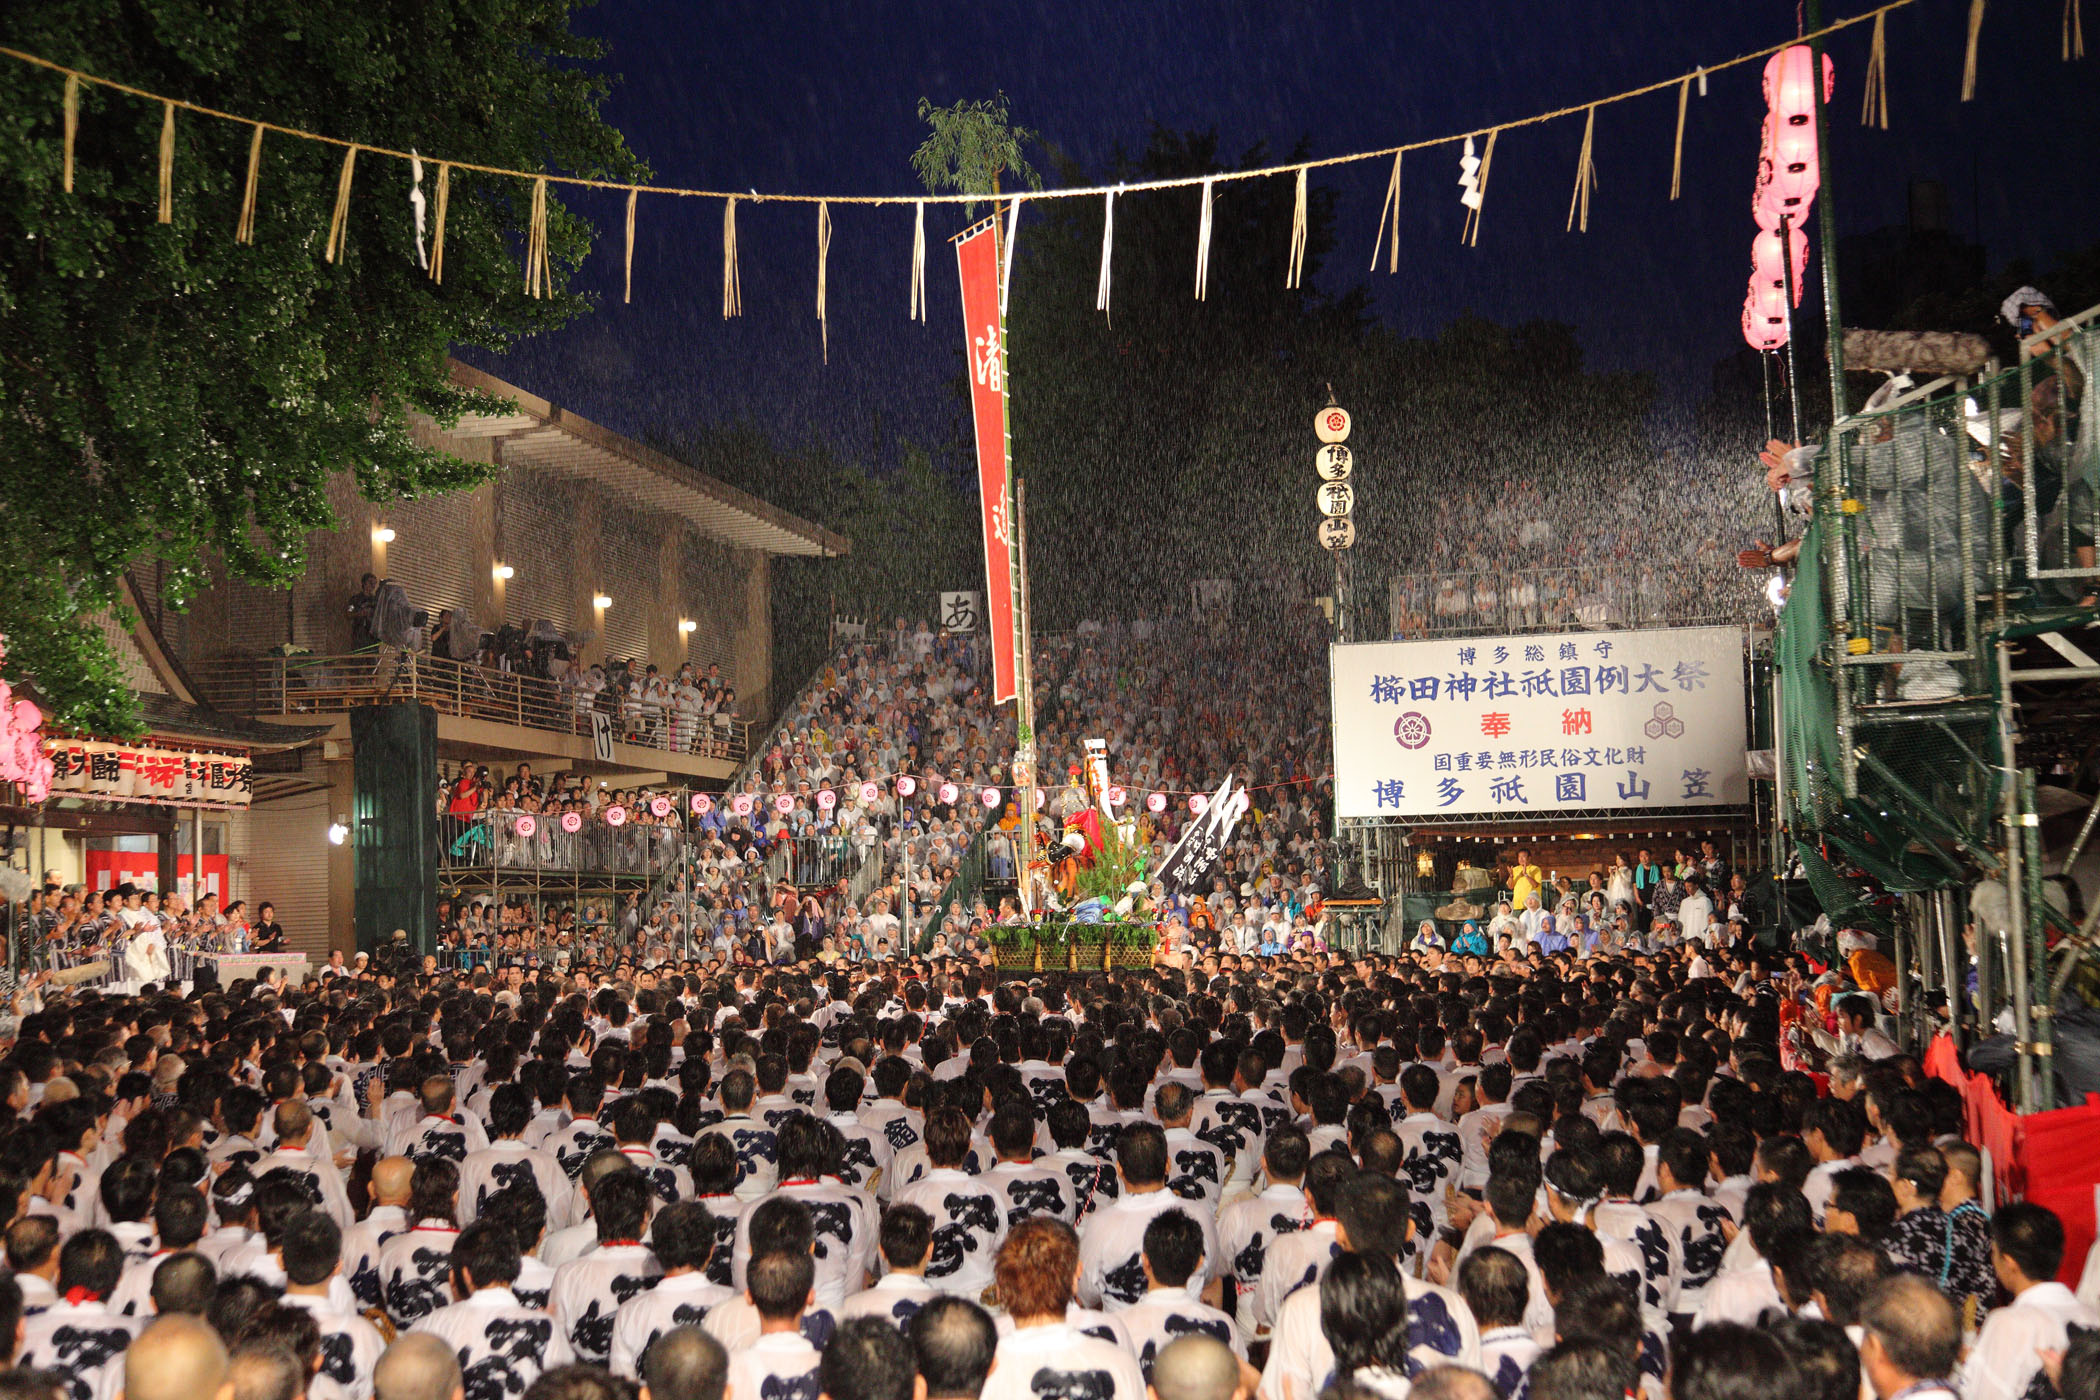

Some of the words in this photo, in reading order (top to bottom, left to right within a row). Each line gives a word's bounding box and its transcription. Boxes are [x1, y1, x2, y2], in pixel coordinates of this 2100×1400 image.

[946, 594, 979, 628] あ
[1457, 640, 1614, 666] 博多総鎮守
[1369, 660, 1711, 705] 櫛田神社祇園例大祭
[595, 715, 611, 758] け
[1480, 707, 1592, 739] 奉納
[1433, 746, 1647, 772] 国重要無形民俗文化財
[1371, 768, 1714, 809] 博多祇園山笠
